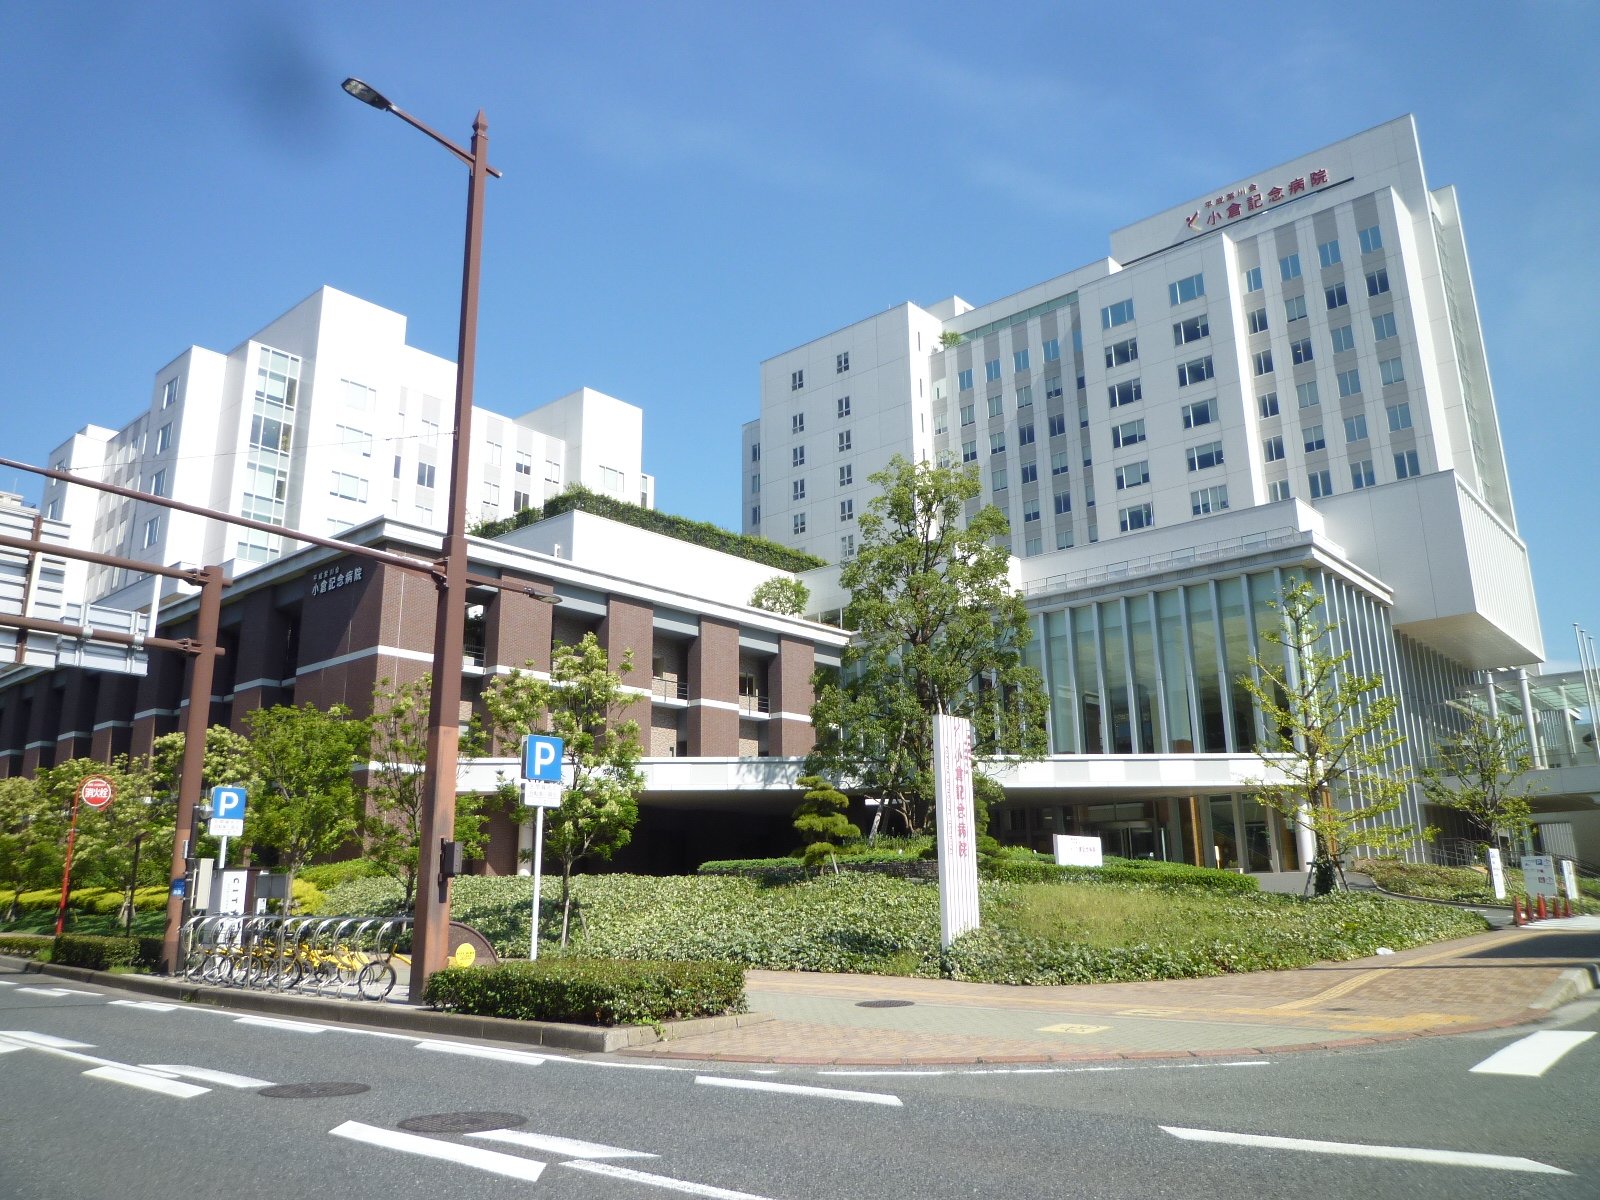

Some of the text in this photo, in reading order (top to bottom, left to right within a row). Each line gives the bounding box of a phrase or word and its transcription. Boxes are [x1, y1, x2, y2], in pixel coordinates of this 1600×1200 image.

[1206, 168, 1329, 226] 小倉記念病院
[311, 566, 363, 597] 小倉記念病院
[534, 741, 556, 776] P
[84, 787, 109, 798] 消火栓
[219, 791, 239, 817] P
[954, 742, 968, 858] 小倉記念病院
